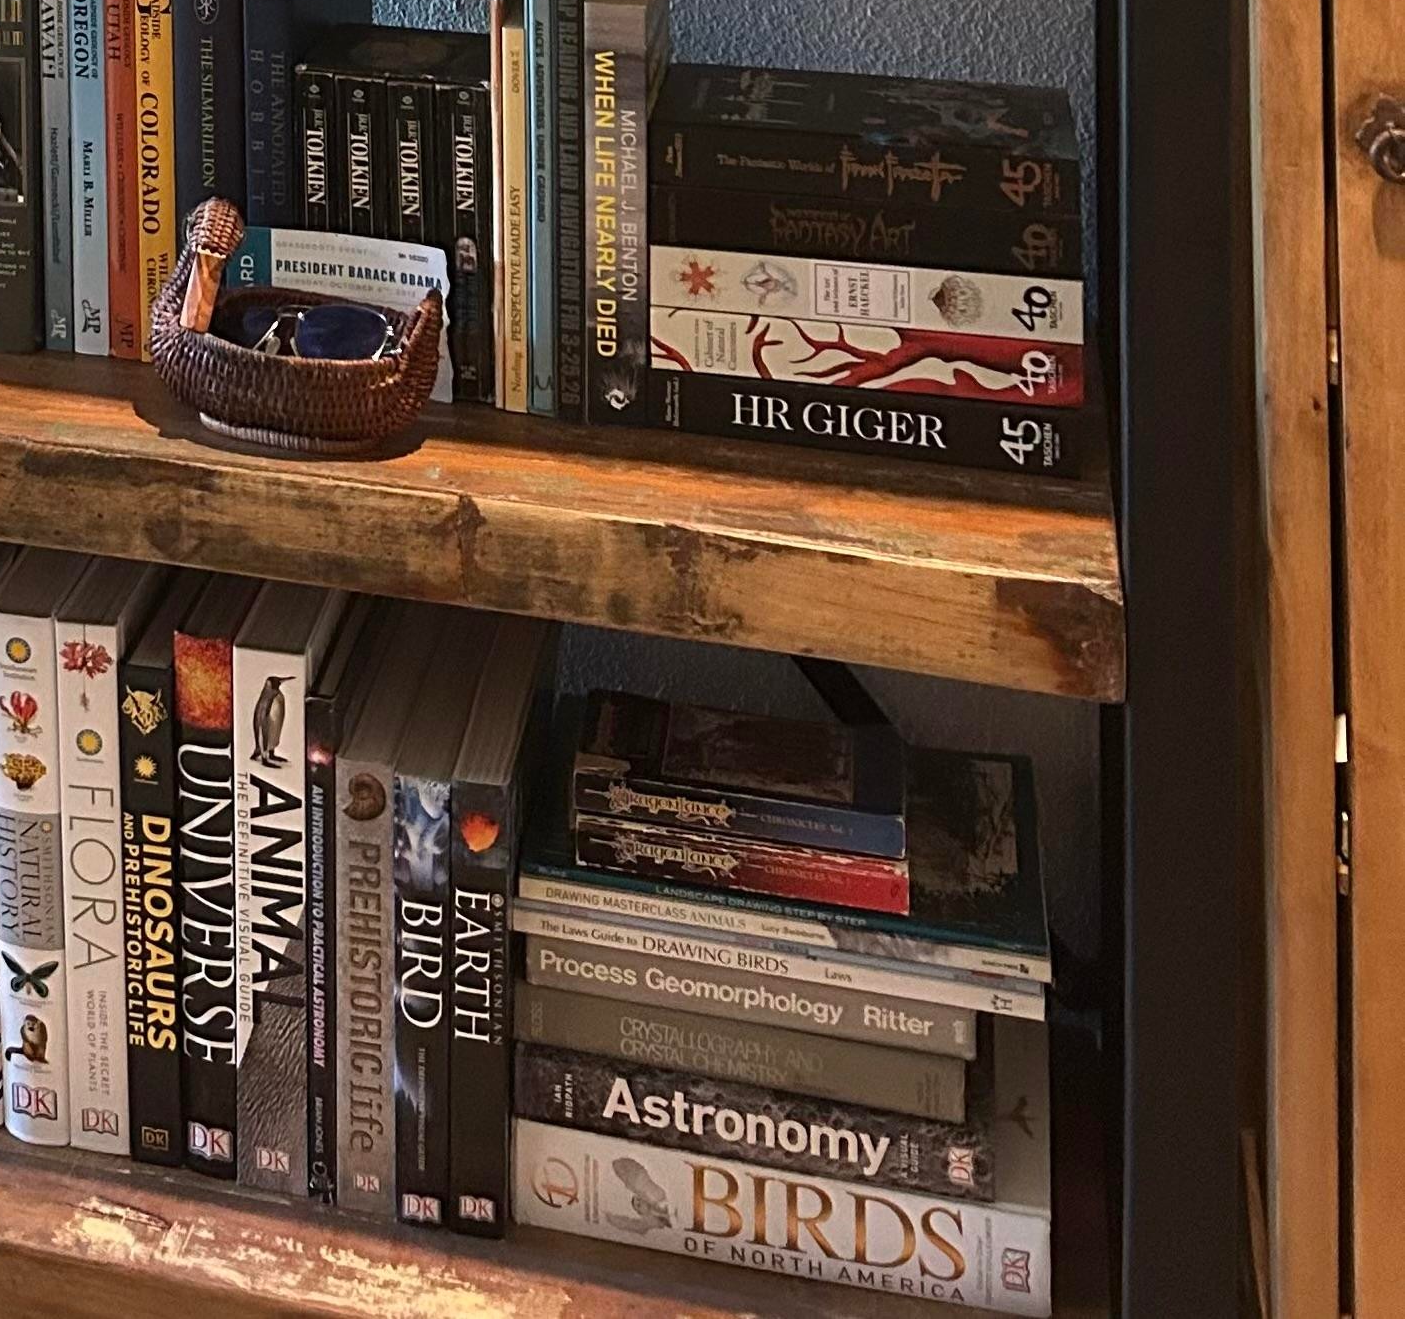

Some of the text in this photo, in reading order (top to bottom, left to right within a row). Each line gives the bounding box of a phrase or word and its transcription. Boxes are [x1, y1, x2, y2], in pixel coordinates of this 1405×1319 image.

[141, 92, 161, 234] COLORADO
[306, 125, 325, 205] TOLKIEN
[594, 51, 617, 358] WHEN LIFE NEARLY DIED
[276, 260, 442, 289] PRESIDENT BARACK OBAMA
[732, 394, 946, 448] HR GIGER
[68, 784, 119, 970] FLORA
[141, 815, 177, 1051] DINOSAURS
[177, 744, 236, 1065] UNIVERSE
[401, 898, 442, 1028] BIRD
[454, 888, 492, 1043] EARTH
[540, 950, 933, 1037] Process Geomorphology Ritter
[13, 1088, 53, 1119] DK
[602, 1077, 890, 1175] Astronomy
[684, 1237, 965, 1303] OF NORTH AMERICA
[685, 1162, 965, 1281] BIRDS
